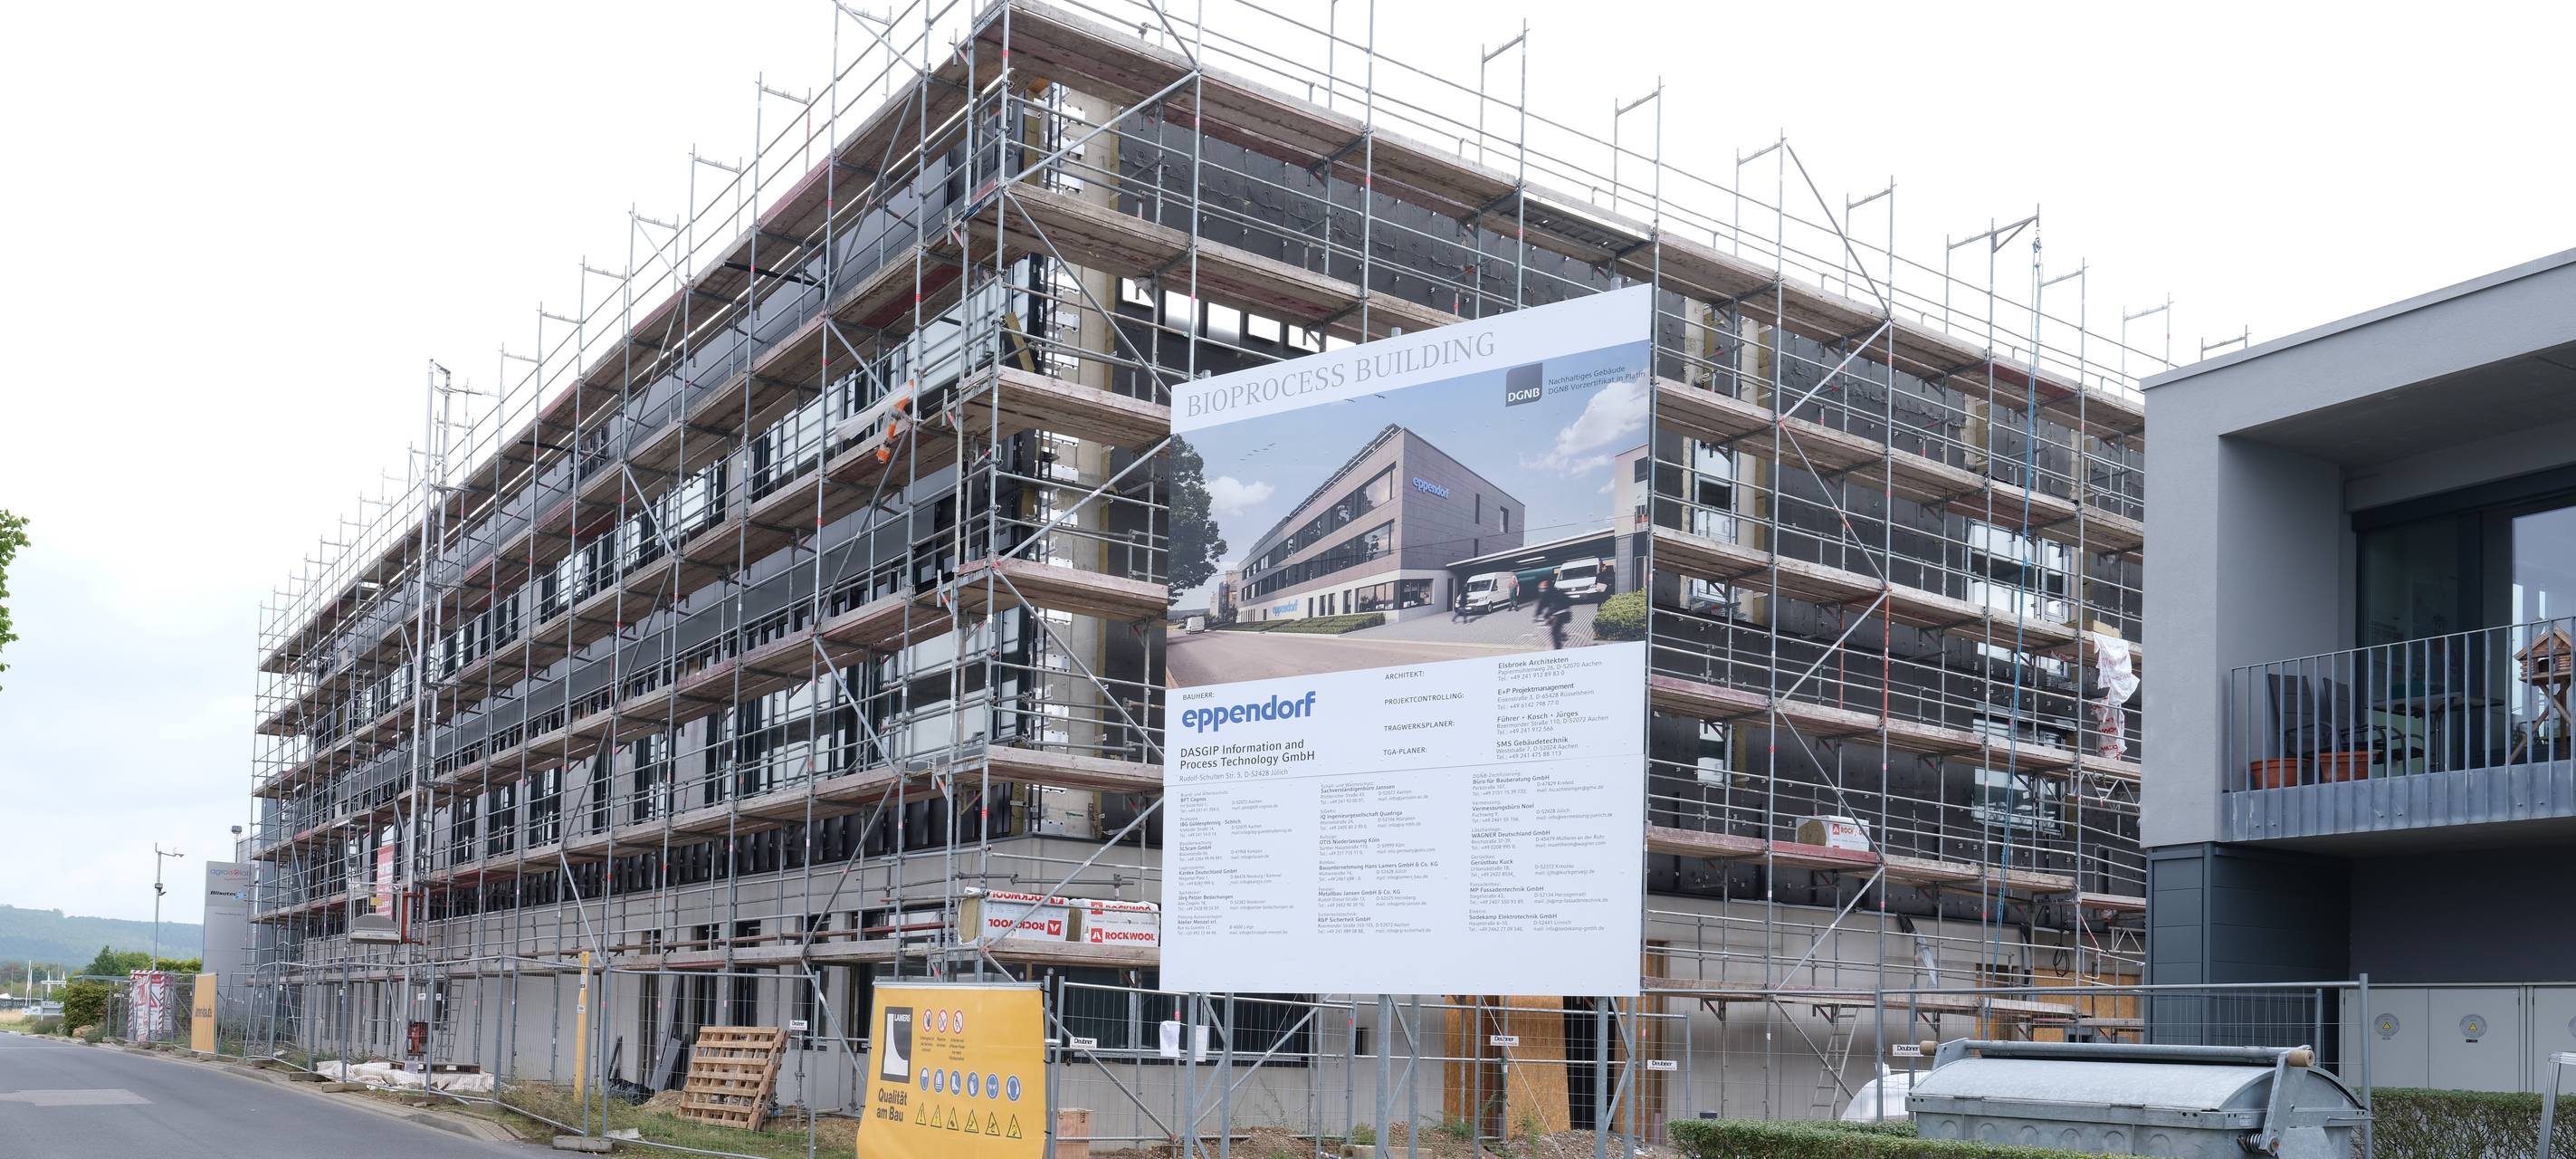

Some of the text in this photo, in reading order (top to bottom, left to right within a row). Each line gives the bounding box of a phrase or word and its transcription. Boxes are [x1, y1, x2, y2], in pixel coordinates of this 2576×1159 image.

[1187, 331, 1495, 418] BIOPROCESS BUILDING
[1549, 366, 1626, 385] Nachhaltiges Gebäude
[1548, 385, 1569, 395] DGNB
[1570, 378, 1614, 390] Vorzertifikat
[1625, 371, 1646, 380] Platin
[1508, 388, 1540, 402] DGNB
[1412, 476, 1450, 499] eppendorf
[1498, 657, 1569, 669] Elsbroek Architekten
[1385, 670, 1425, 680] ARCHITEKT:
[1512, 683, 1574, 694] Projektmanagement
[1182, 692, 1214, 700] BAUHERR:
[1384, 693, 1465, 705] PROJEKTCONTROLLING:
[1182, 691, 1315, 733] eppendorf
[1497, 710, 1579, 723] Führer Kosch Jürges
[1384, 721, 1455, 732] TRAGWERKSPLANER:
[1513, 736, 1568, 746] Gebäudetechnik
[1180, 739, 1304, 757] DASGIP Information and
[1383, 747, 1427, 756] TGA-PLANER:
[1180, 751, 1314, 770] Process Technology GmbH
[1105, 932, 1155, 942] ROCKWOOL
[878, 1088, 908, 1106] Qualität
[876, 1106, 903, 1122] am Bau
